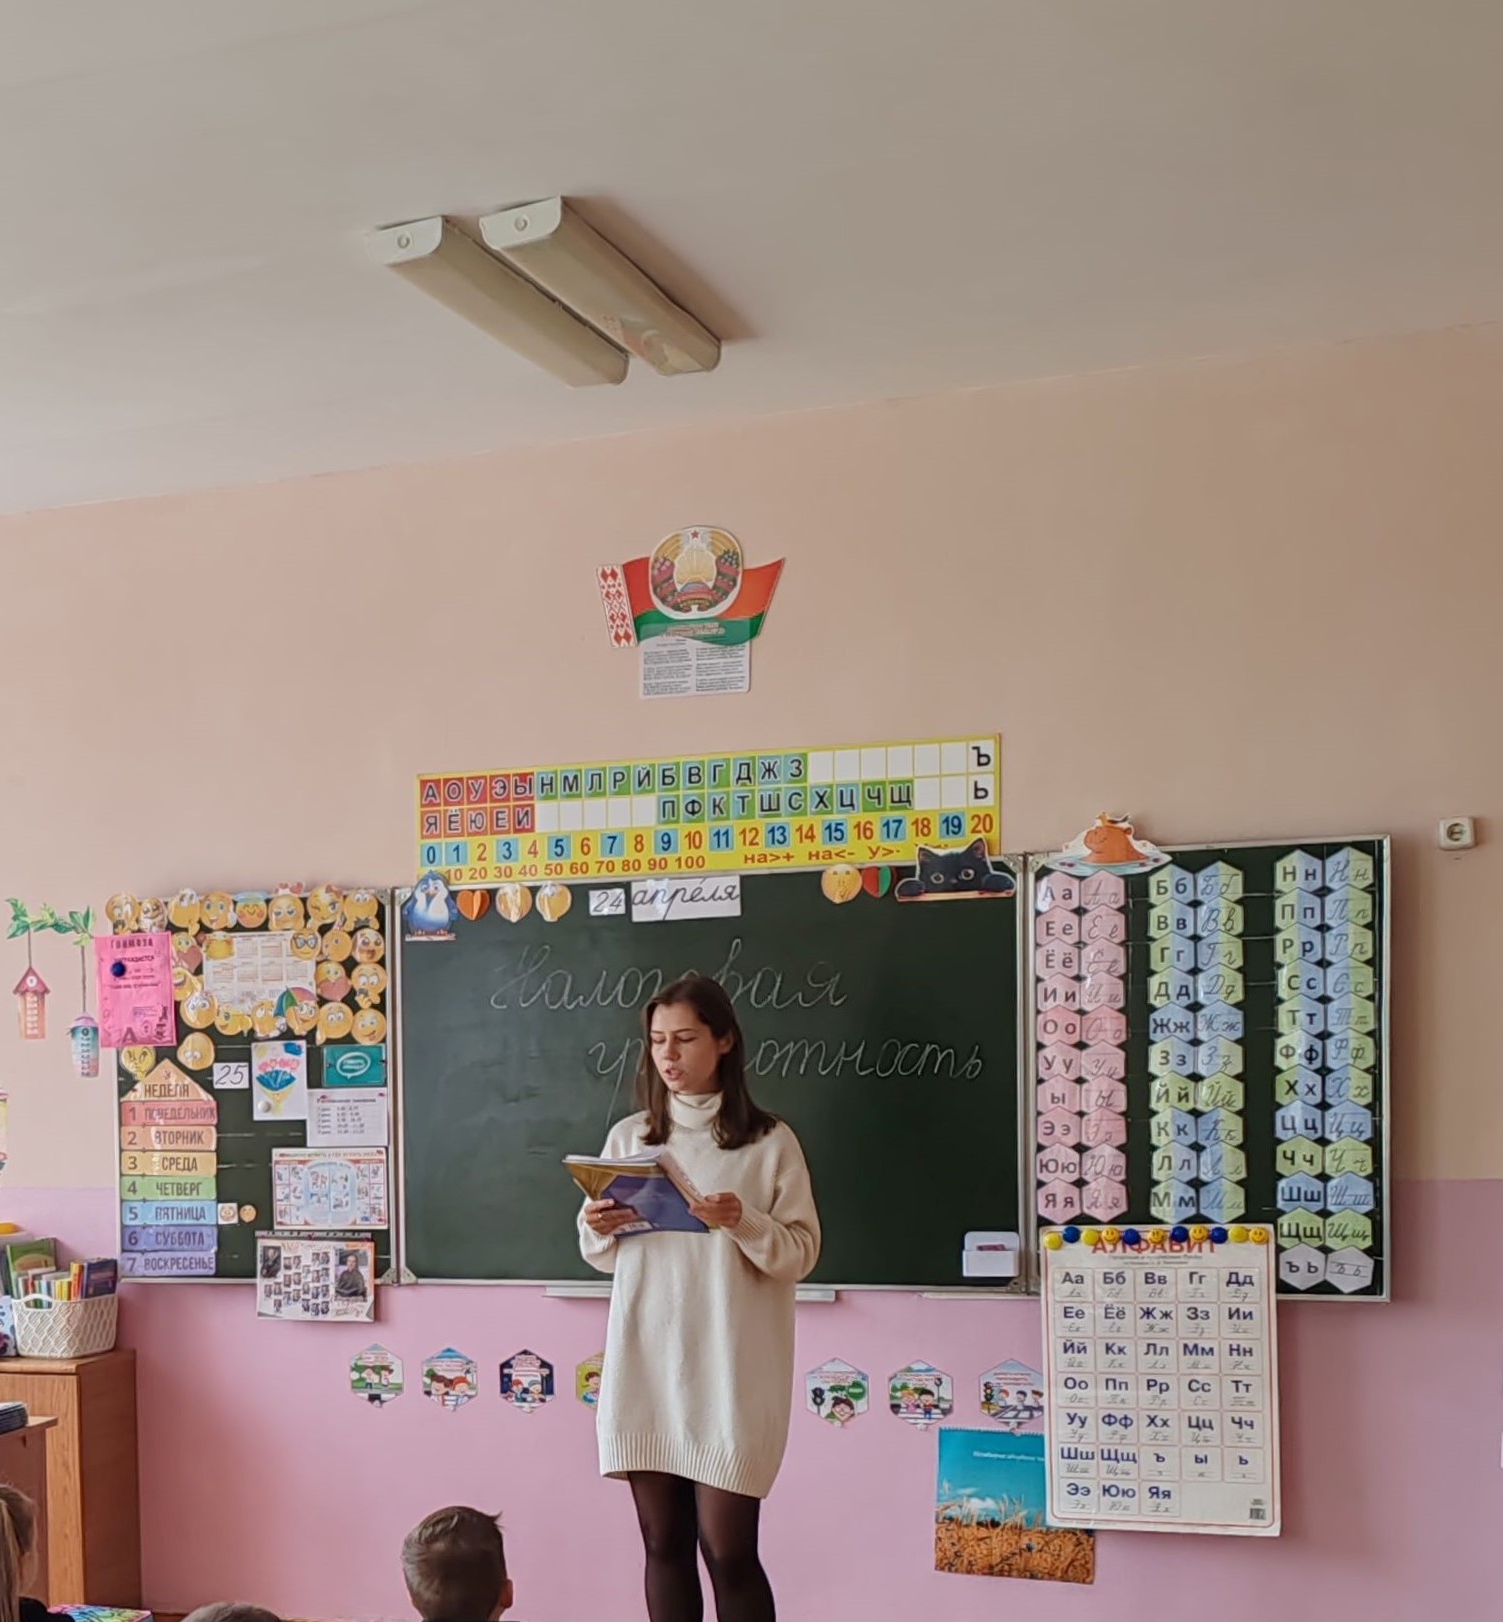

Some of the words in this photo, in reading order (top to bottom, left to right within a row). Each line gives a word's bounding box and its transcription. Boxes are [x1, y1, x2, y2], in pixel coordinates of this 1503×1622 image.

[424, 784, 438, 802] А
[447, 782, 462, 800] О
[469, 781, 483, 798] У
[494, 779, 507, 797] Э
[514, 777, 533, 796] Ы
[541, 776, 554, 794] Н
[563, 775, 579, 793] М
[588, 773, 602, 791] Л
[613, 771, 625, 789] Р
[637, 766, 651, 788] Й
[661, 767, 675, 786] Б
[688, 766, 702, 784] В
[712, 764, 724, 783] Г
[736, 762, 752, 784] Д
[761, 760, 778, 780] Ж
[789, 758, 803, 778] З
[972, 746, 991, 767] Ъ
[425, 815, 438, 833] Я
[448, 809, 460, 831] Ё
[470, 812, 485, 830] Ю
[495, 810, 507, 828] Е
[517, 808, 531, 827] И
[662, 800, 675, 818] П
[685, 799, 702, 816] Ф
[712, 797, 725, 815] К
[736, 795, 750, 813] Т
[760, 793, 780, 812] Ш
[788, 792, 803, 811] С
[815, 790, 829, 810] Х
[839, 788, 855, 811] Ц
[867, 787, 882, 806] Ч
[890, 784, 912, 806] Щ
[974, 780, 989, 800] Ь
[426, 845, 436, 864] 0
[452, 844, 460, 863] 1
[476, 842, 487, 862] 2
[502, 841, 513, 860] 3
[527, 839, 539, 858] 4
[554, 838, 565, 857] 5
[580, 837, 591, 856] 6
[607, 835, 618, 854] 7
[634, 833, 645, 853] 8
[660, 832, 672, 851] 9
[684, 830, 703, 850] 10
[712, 828, 730, 848] 11
[739, 827, 760, 846] 12
[767, 825, 787, 845] 13
[795, 823, 816, 844] 14
[824, 822, 845, 842] 15
[853, 820, 874, 841] 16
[882, 819, 903, 839] 17
[911, 817, 931, 837] 18
[941, 815, 962, 836] 19
[970, 813, 994, 834] 20
[445, 868, 463, 882] 10
[468, 867, 488, 881] 20
[493, 865, 513, 879] 30
[518, 864, 538, 878] 40
[544, 863, 563, 876] 50
[569, 861, 589, 875] 60
[596, 860, 615, 873] 70
[621, 858, 641, 871] 80
[647, 857, 668, 870] 90
[675, 855, 706, 869] 100
[592, 891, 623, 913] 24
[490, 938, 848, 1010] Налогвая
[214, 1064, 249, 1086] 25
[588, 1037, 983, 1128] гротность
[144, 1083, 190, 1098] НЕДЕЛЯ
[129, 1106, 136, 1121] 1
[144, 1107, 216, 1120] ПОНЕДЕЛЬНИК
[127, 1131, 137, 1146] 2
[154, 1130, 204, 1145] ВТОРНИК
[128, 1156, 138, 1171] 3
[161, 1156, 198, 1171] СРЕДА
[127, 1180, 137, 1195] 4
[155, 1181, 203, 1197] ЧЕТВЕРГ
[128, 1206, 139, 1221] 5
[155, 1206, 207, 1222] ПЯТНИЦА
[128, 1230, 139, 1246] 6
[155, 1231, 205, 1246] СУББОТА
[126, 1257, 137, 1273] 7
[143, 1257, 214, 1271] ВОСКРЕСЕНЬЕ
[1061, 1272, 1085, 1285] Аа
[1102, 1271, 1127, 1285] Бб
[1144, 1272, 1168, 1285] Вв
[1188, 1271, 1207, 1285] Гг
[1225, 1272, 1255, 1287] Дд
[1062, 1306, 1086, 1319] Ее
[1103, 1304, 1126, 1320] Ёё
[1138, 1306, 1174, 1320] Жж
[1186, 1306, 1210, 1321] Зз
[1227, 1307, 1254, 1321] Ии
[1062, 1338, 1088, 1355] Йй
[1104, 1342, 1127, 1356] Кк
[1143, 1343, 1169, 1356] Лл
[1182, 1343, 1215, 1357] Мм
[1228, 1343, 1254, 1357] Нн
[1063, 1377, 1089, 1391] Оо
[1104, 1378, 1129, 1392] Пп
[1146, 1378, 1170, 1396] Рр
[1187, 1379, 1212, 1393] Сс
[1231, 1380, 1253, 1394] Тт
[1066, 1412, 1088, 1428] Уу
[1101, 1413, 1134, 1429] Фф
[1145, 1414, 1171, 1429] Хх
[1187, 1415, 1215, 1431] Цц
[1230, 1416, 1255, 1430] Чч
[1060, 1447, 1095, 1460] Шш
[1100, 1448, 1138, 1464] Щщ
[1153, 1452, 1166, 1463] ъ
[1194, 1453, 1209, 1465] ы
[1238, 1454, 1249, 1466] ь
[1066, 1482, 1091, 1497] Ээ
[1101, 1484, 1136, 1499] Юю
[1147, 1485, 1172, 1500] Яя
